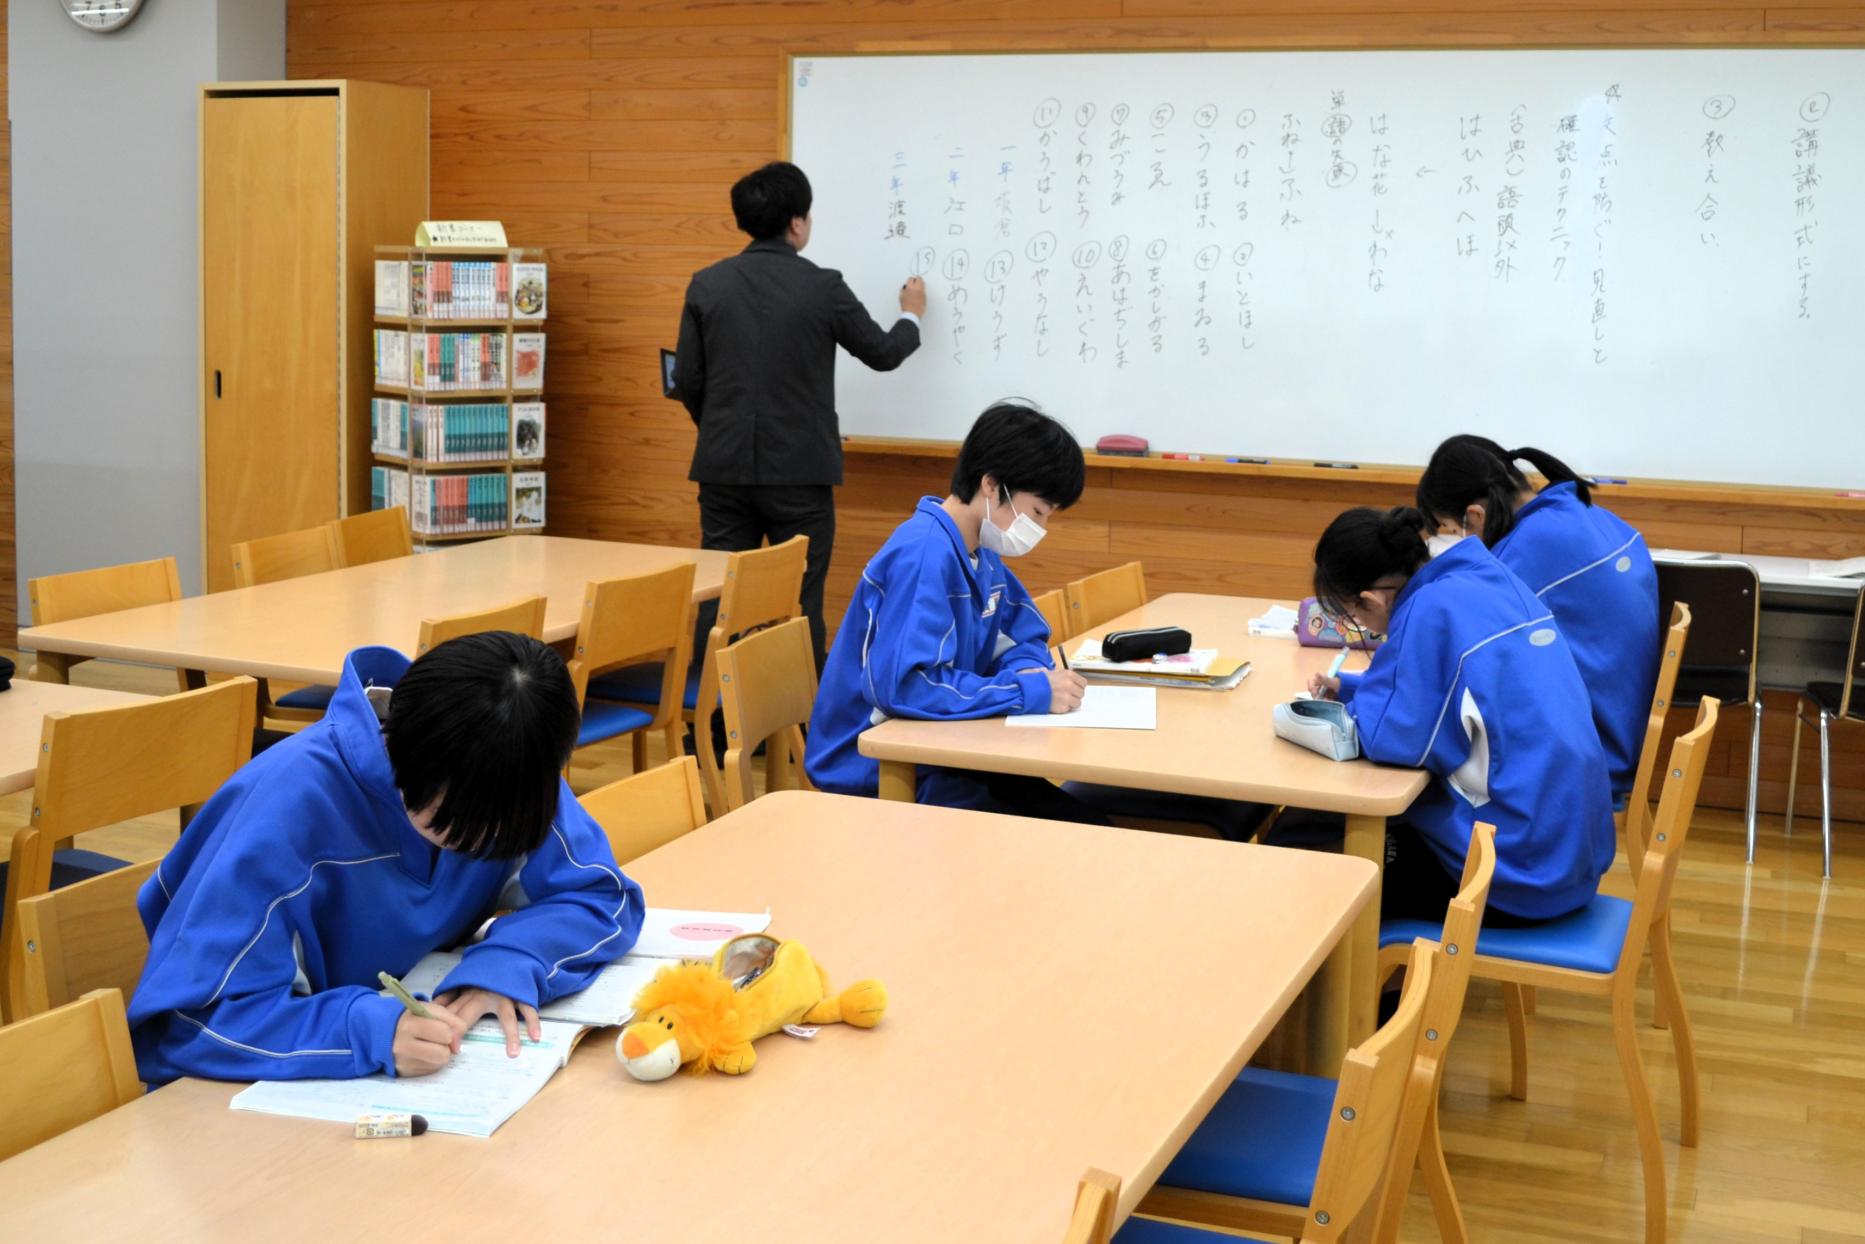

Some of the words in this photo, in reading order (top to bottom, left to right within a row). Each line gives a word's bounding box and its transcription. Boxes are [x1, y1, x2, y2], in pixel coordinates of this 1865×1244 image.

[1455, 112, 1484, 258] はひふへほ
